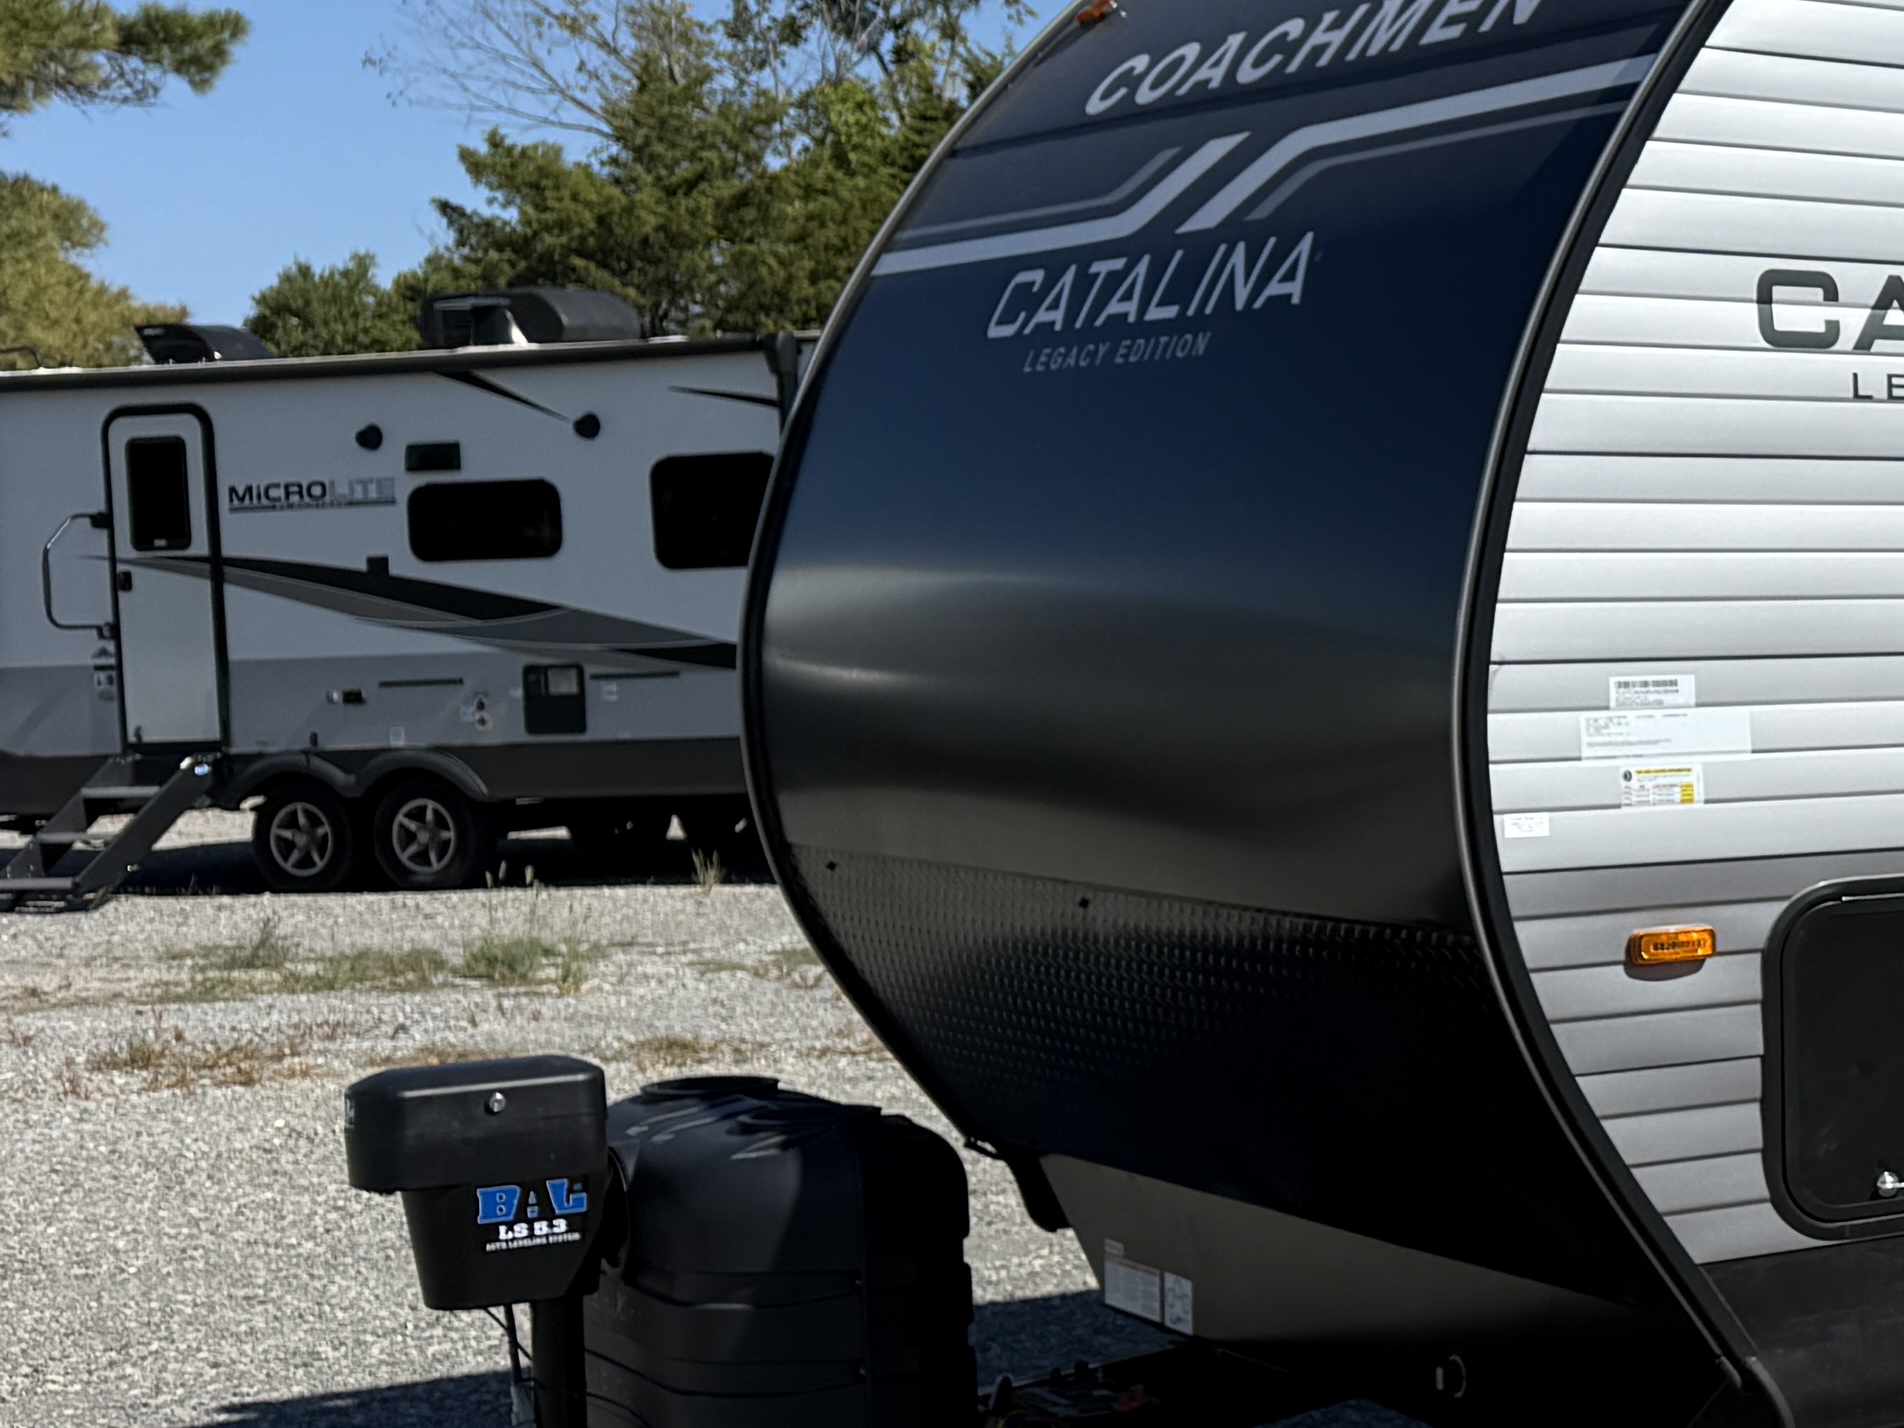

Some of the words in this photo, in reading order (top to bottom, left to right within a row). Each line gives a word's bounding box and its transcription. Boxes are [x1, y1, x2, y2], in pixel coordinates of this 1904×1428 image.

[987, 231, 1314, 339] CATALINA
[1023, 342, 1110, 373] LEGACY
[1113, 331, 1212, 364] EDITION
[498, 1222, 529, 1240] LS
